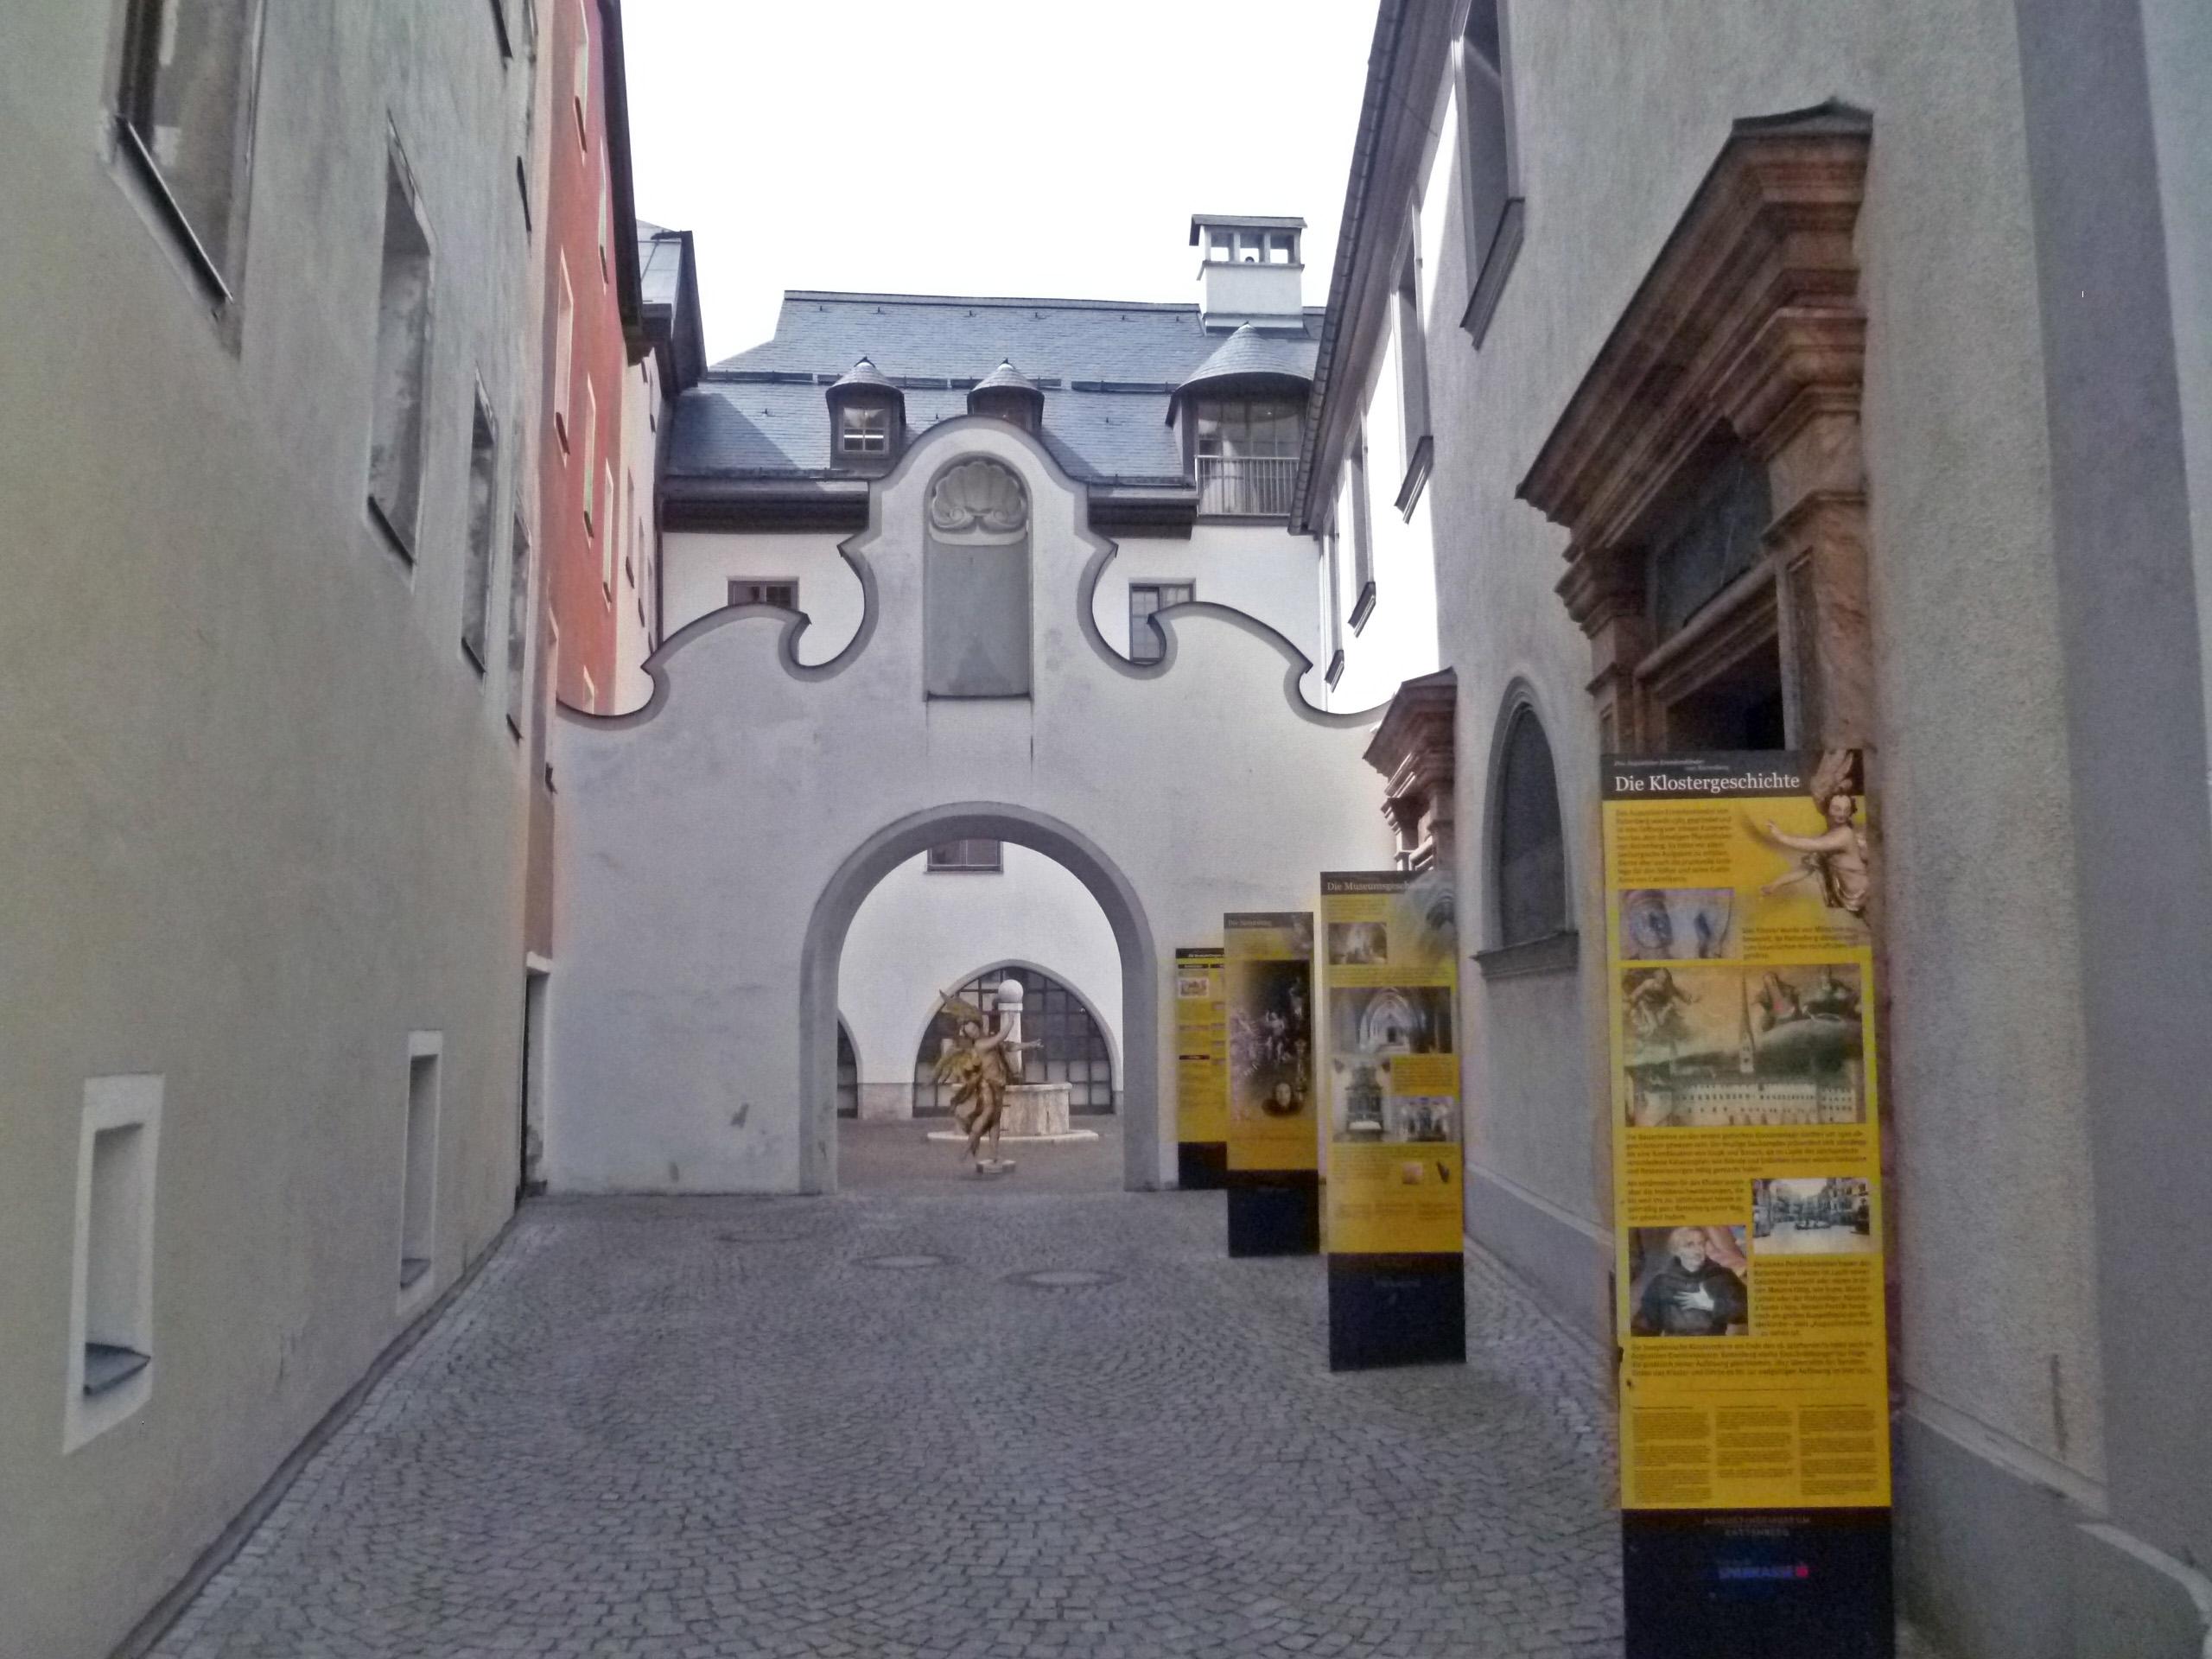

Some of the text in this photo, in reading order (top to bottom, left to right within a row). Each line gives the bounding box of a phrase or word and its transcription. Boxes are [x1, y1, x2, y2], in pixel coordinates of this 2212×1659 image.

[1615, 772, 1800, 794] Die Klostergeschichte
[1327, 881, 1342, 891] Die
